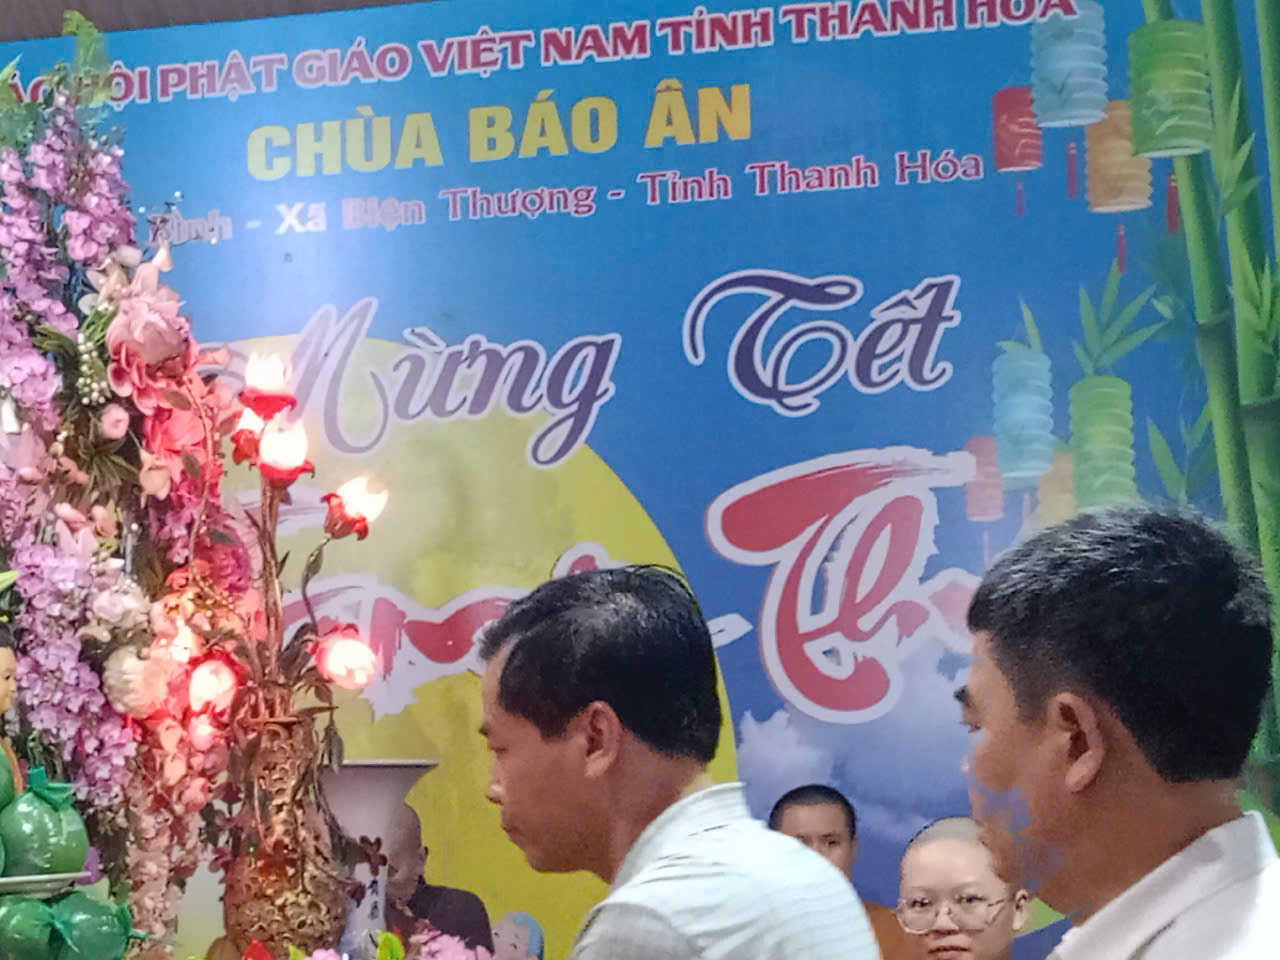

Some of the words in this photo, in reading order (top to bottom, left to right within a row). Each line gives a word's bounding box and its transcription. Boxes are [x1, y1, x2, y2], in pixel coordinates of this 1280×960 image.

[157, 48, 287, 101] PHẬT
[293, 36, 411, 90] GIÁO
[418, 25, 531, 79] VIỆT
[540, 21, 650, 66] NAM
[779, 0, 958, 42] THANH
[246, 105, 444, 182] CHÙA
[468, 88, 618, 163] BÁO
[644, 76, 752, 149] ÂN
[441, 182, 596, 219] Thượng
[636, 167, 732, 206] Tỉnh
[746, 155, 879, 197] Thanh
[896, 148, 985, 185] Hóa
[210, 297, 622, 468] Mừng
[683, 268, 963, 418] Tết
[705, 446, 986, 724] Th
